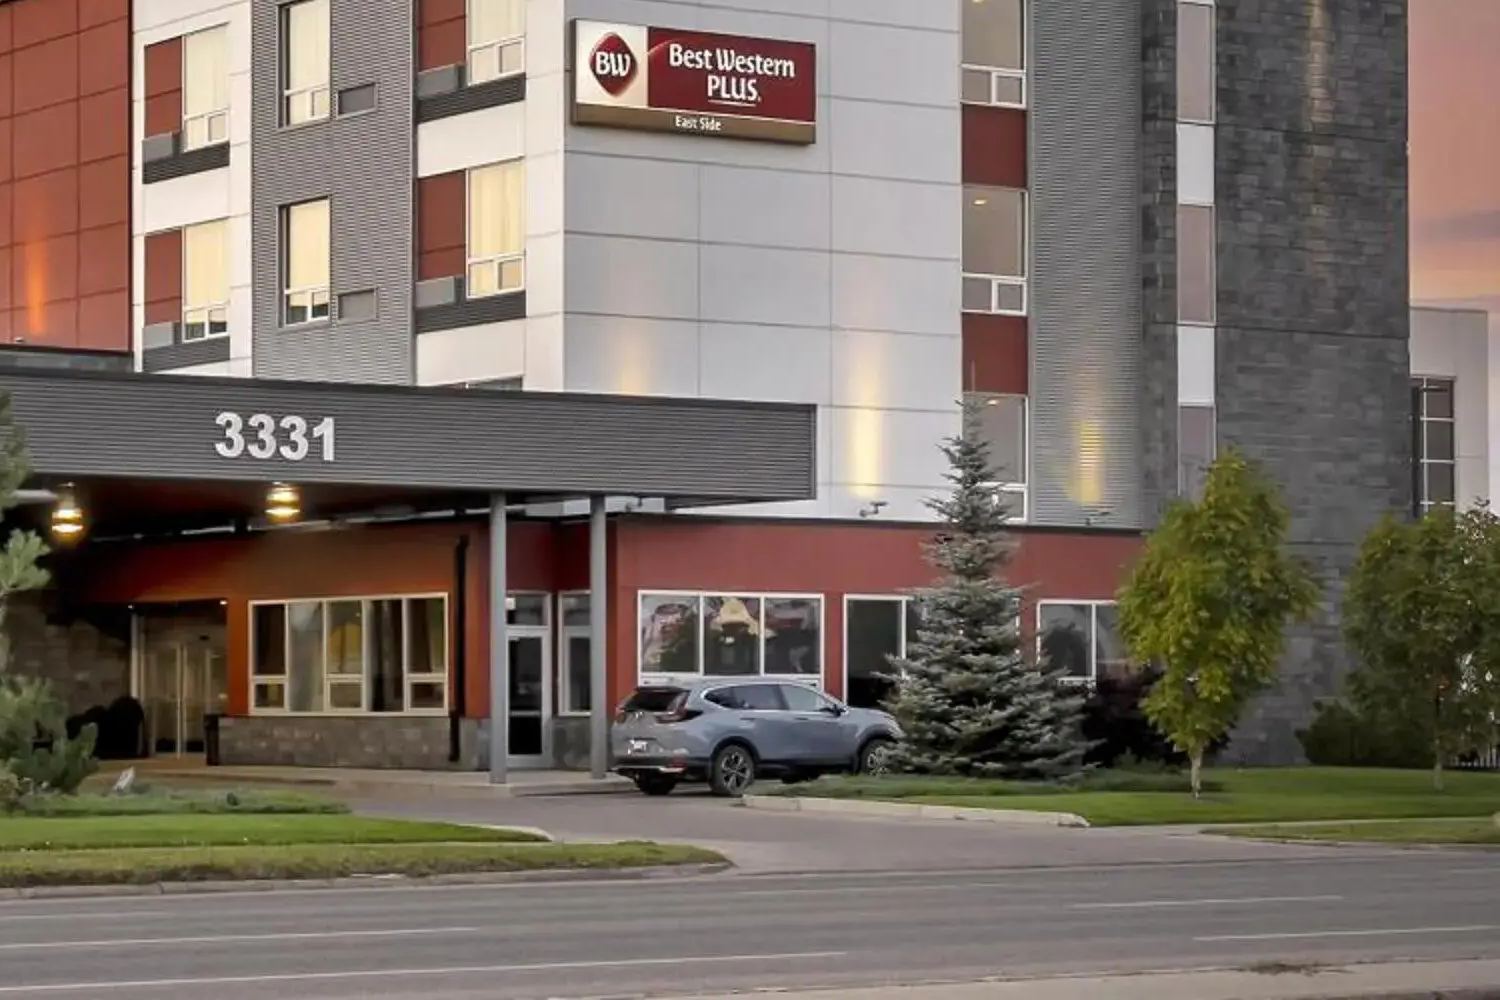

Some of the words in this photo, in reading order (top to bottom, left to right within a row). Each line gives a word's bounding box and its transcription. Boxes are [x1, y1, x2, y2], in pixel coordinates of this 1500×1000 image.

[596, 51, 631, 77] BW
[669, 43, 712, 70] Best
[716, 49, 795, 78] Western
[708, 75, 758, 101] PLUS
[675, 115, 699, 129] East
[700, 117, 721, 132] Side
[215, 411, 335, 462] 3331
